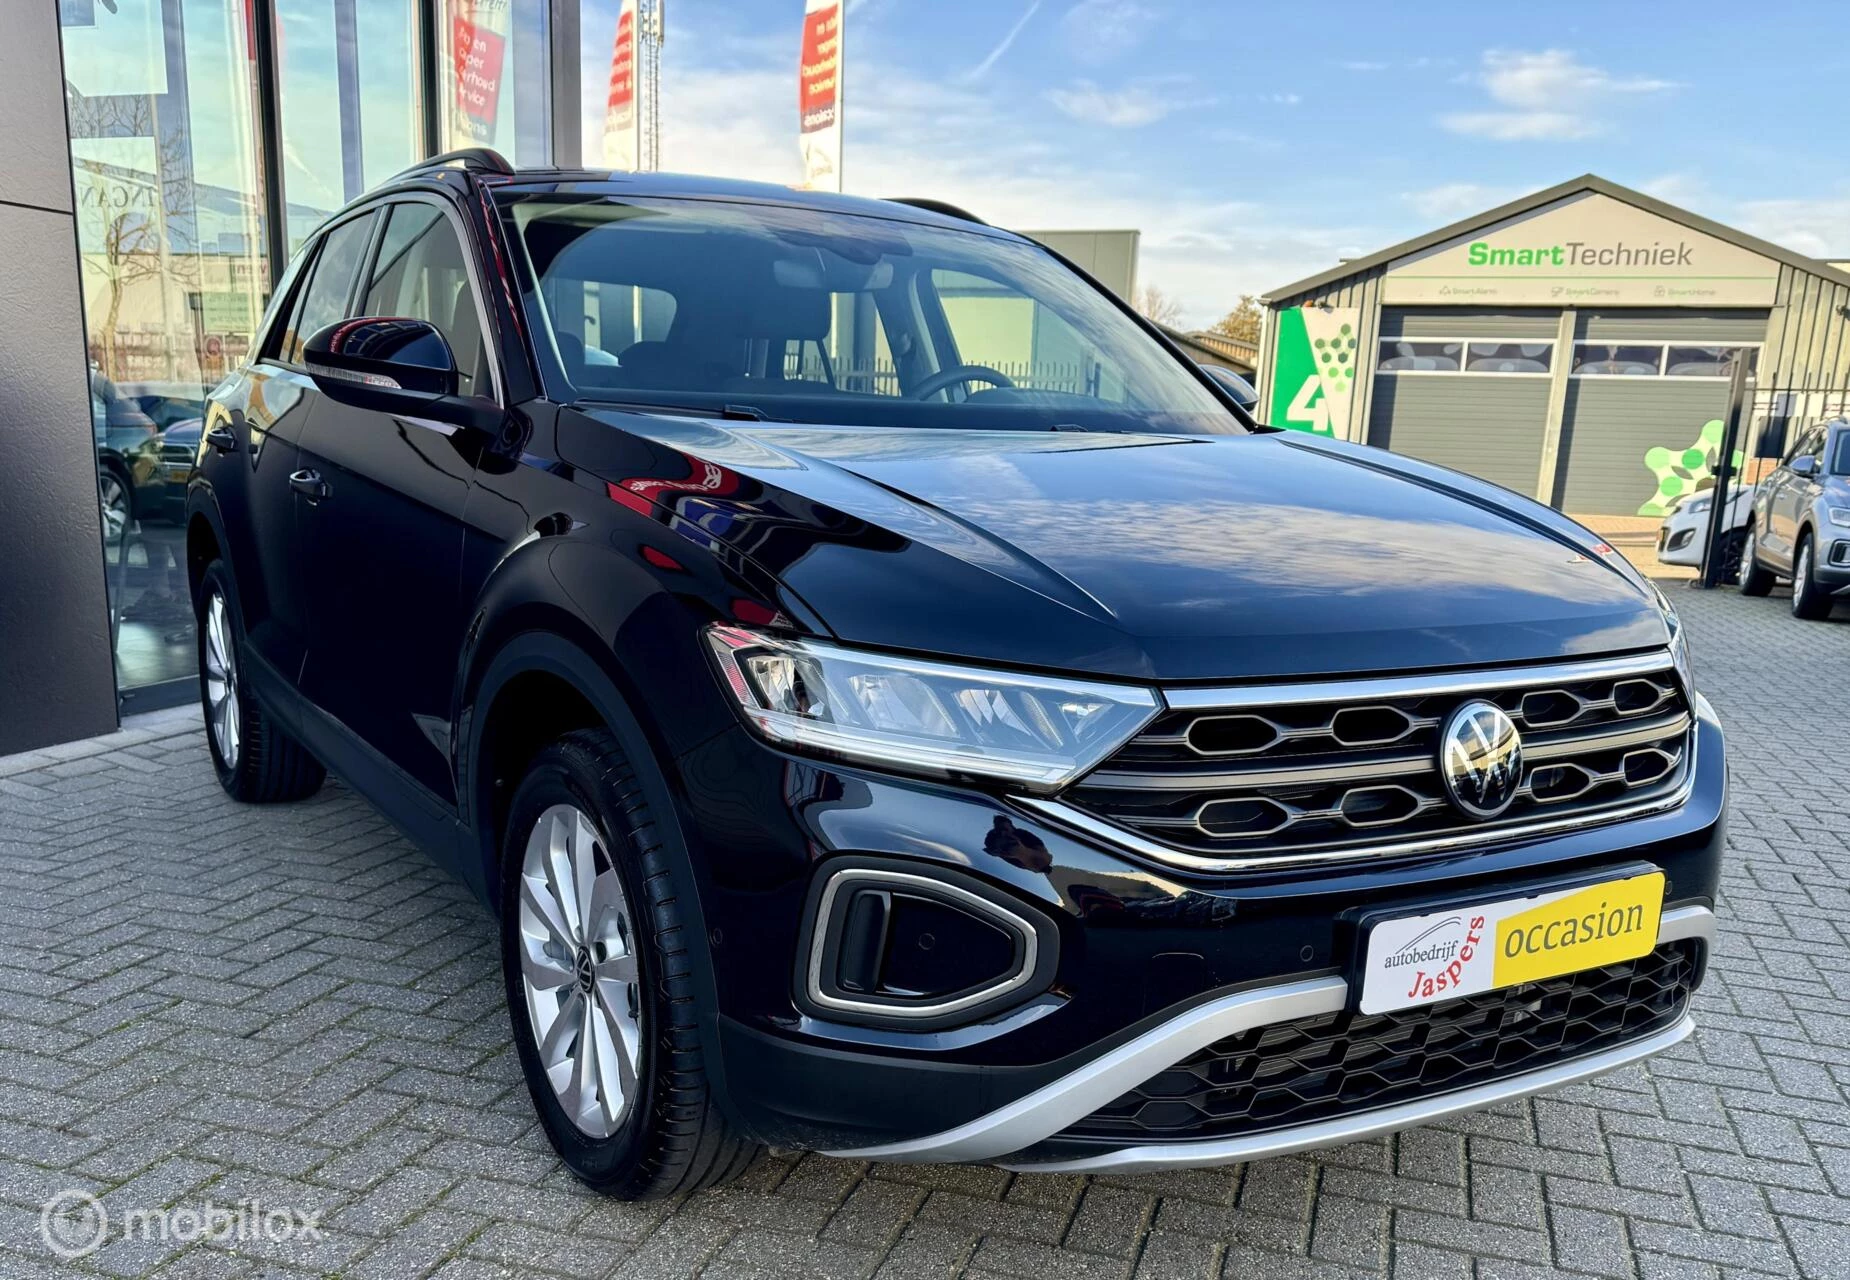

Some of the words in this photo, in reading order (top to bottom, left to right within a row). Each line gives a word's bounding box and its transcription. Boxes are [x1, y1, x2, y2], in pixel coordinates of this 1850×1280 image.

[1468, 242, 1693, 266] SmartTechniek
[1286, 374, 1330, 431] 4
[1384, 940, 1458, 969] autobedrijf
[1408, 914, 1485, 999] Jaspers
[1504, 902, 1643, 958] occasion
